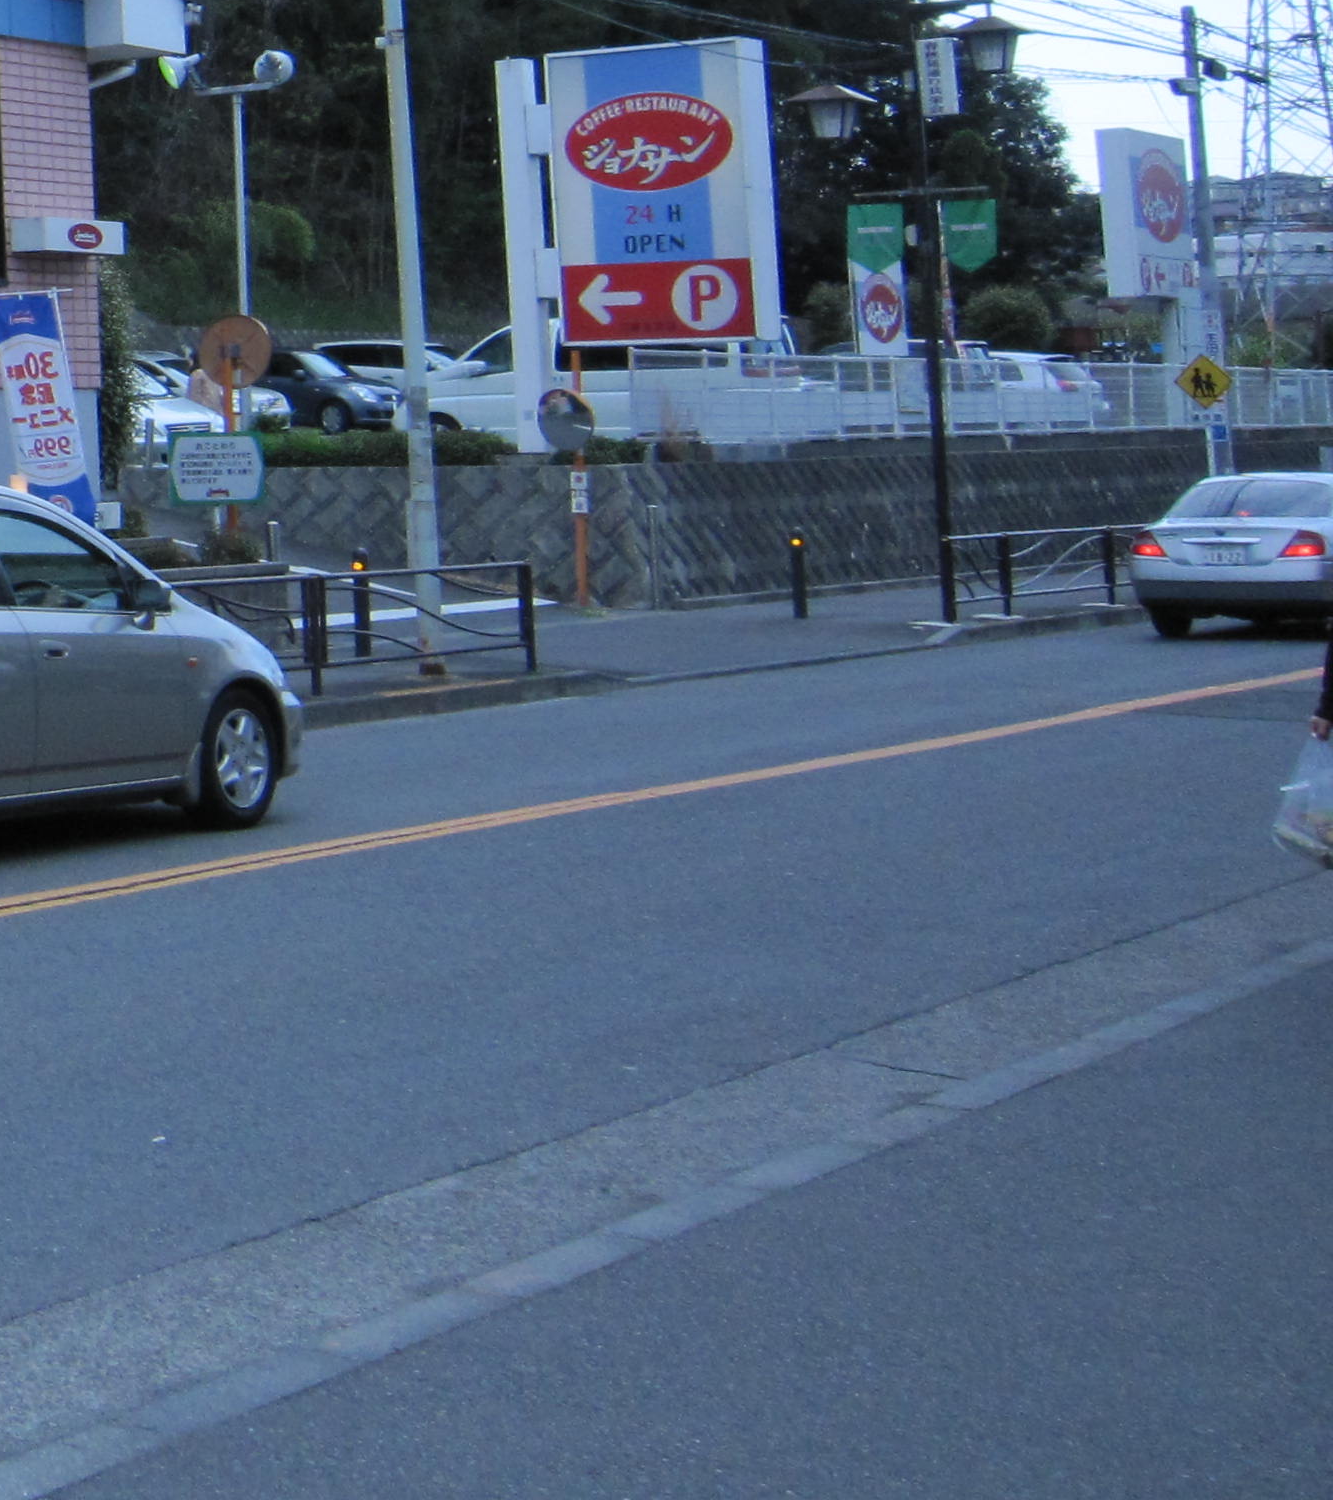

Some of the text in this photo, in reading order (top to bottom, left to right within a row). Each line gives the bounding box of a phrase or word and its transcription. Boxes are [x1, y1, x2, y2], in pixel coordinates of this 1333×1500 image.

[582, 130, 716, 185] ジョナサン
[625, 204, 682, 225] 24 H
[624, 233, 686, 254] OPEN
[689, 274, 722, 322] P
